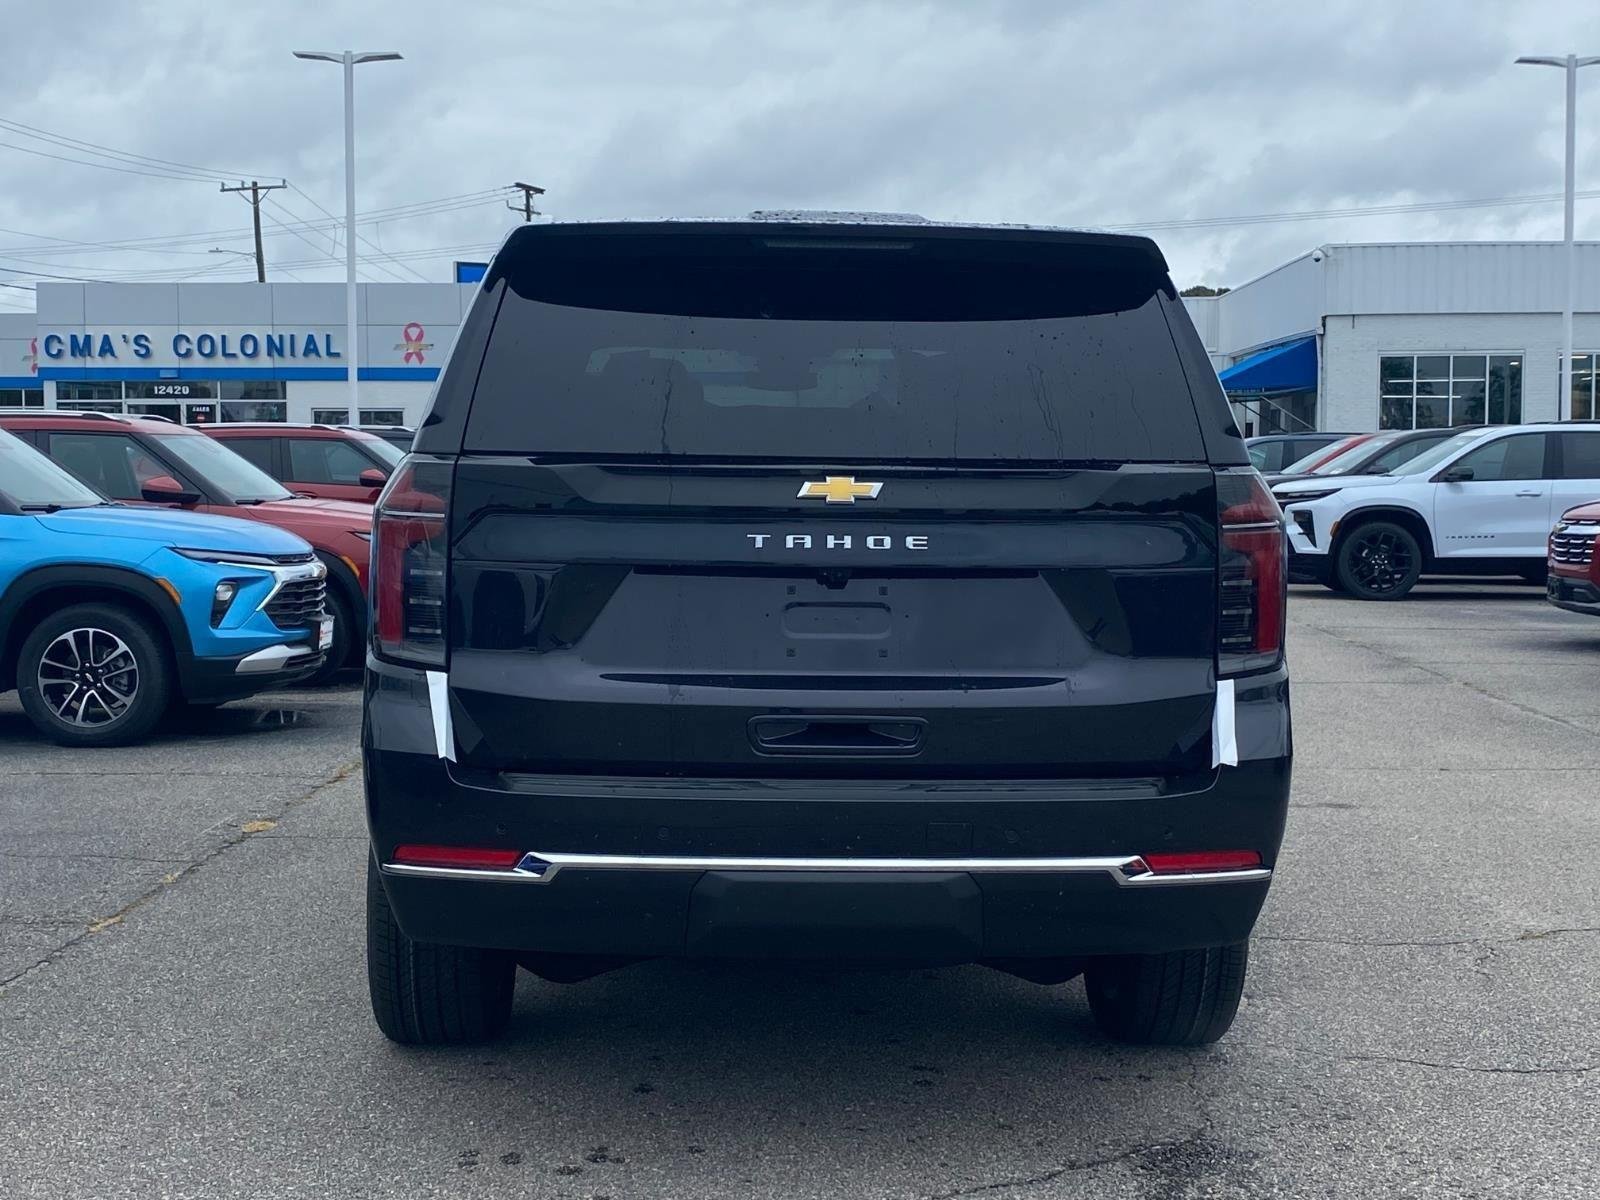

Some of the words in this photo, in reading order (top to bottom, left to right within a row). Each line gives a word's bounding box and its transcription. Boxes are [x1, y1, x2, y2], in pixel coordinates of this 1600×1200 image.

[44, 333, 152, 359] CMA'S
[172, 333, 342, 359] COLONIAL
[154, 385, 190, 395] 12420
[747, 534, 928, 549] TAHOE
